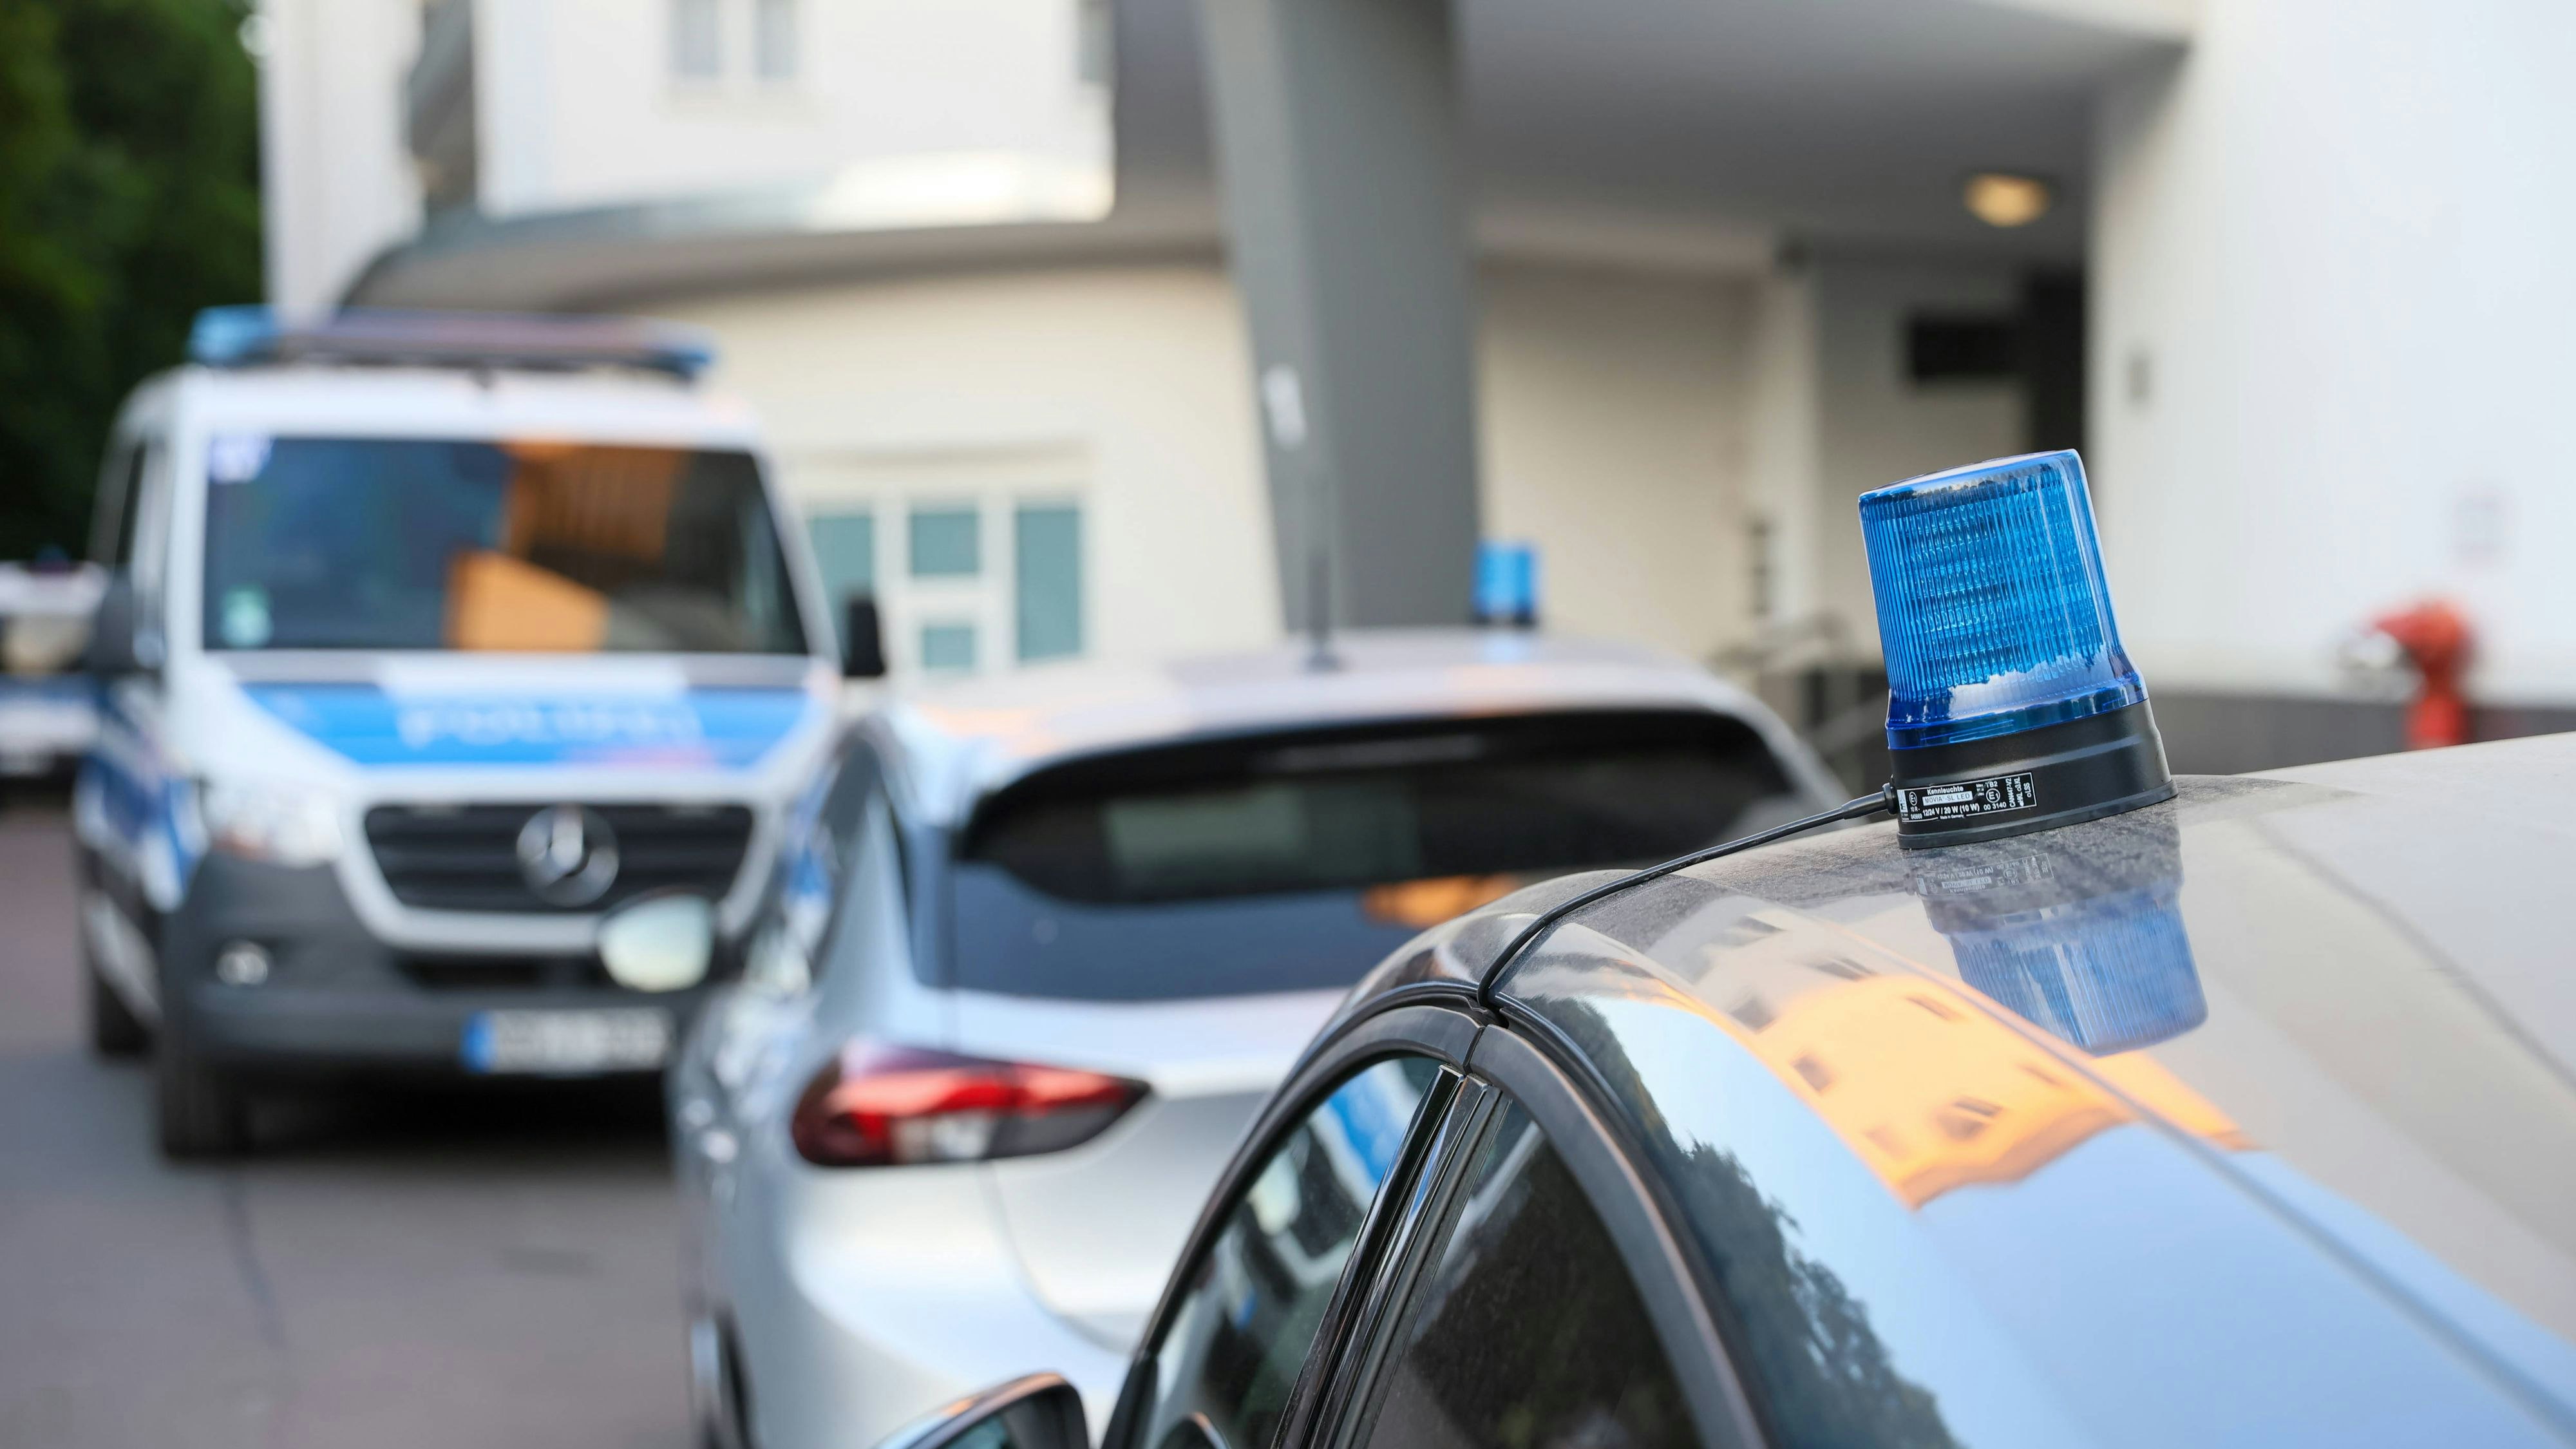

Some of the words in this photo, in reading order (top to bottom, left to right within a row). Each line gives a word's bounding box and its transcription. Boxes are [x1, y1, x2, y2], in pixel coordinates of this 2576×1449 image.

[1927, 786, 1964, 795] Kennleuchte
[1922, 808, 1935, 817] 12/24
[1944, 806, 1951, 814] 20
[1951, 805, 1958, 813] W
[1959, 804, 1969, 814] (10
[1969, 803, 1980, 812] W)
